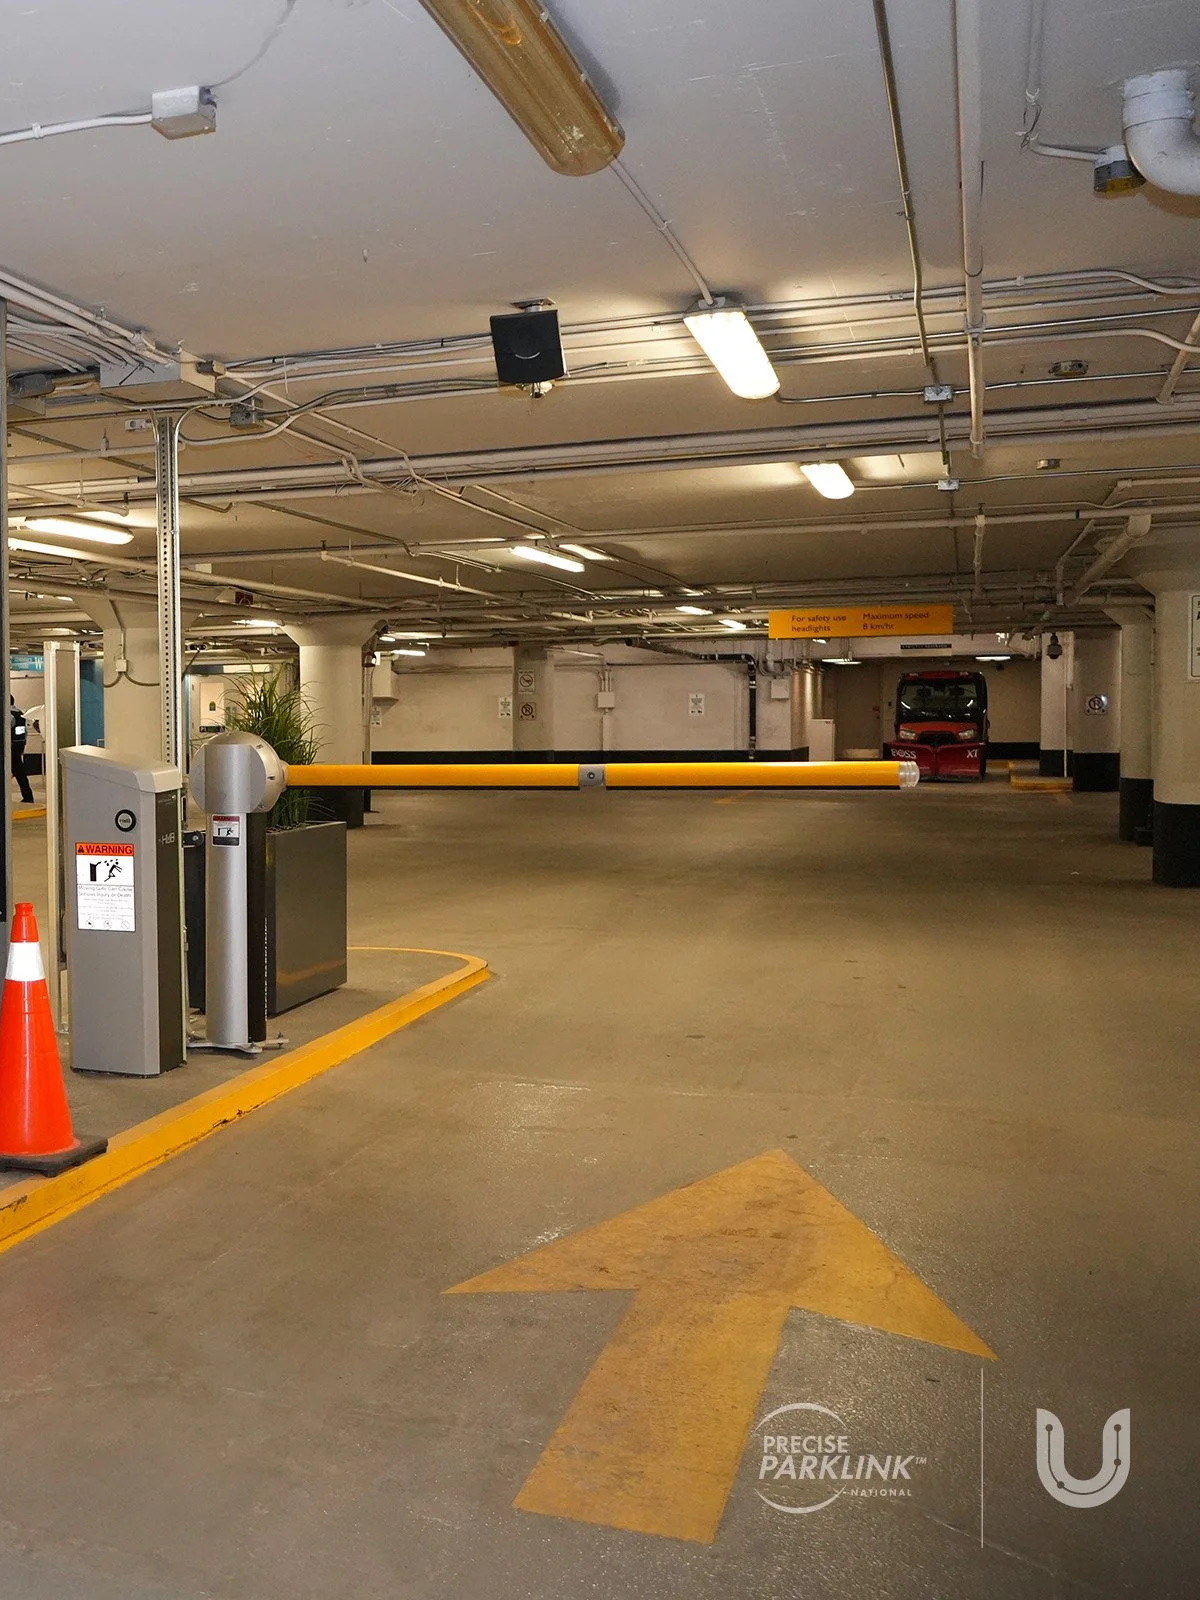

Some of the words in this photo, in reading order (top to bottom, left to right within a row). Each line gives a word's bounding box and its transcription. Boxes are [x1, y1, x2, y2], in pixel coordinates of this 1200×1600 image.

[792, 615, 805, 623] For
[808, 614, 831, 623] safety
[863, 612, 902, 620] Maximum
[905, 612, 929, 620] speed
[792, 624, 831, 632] headlights
[86, 845, 133, 855] WARNING
